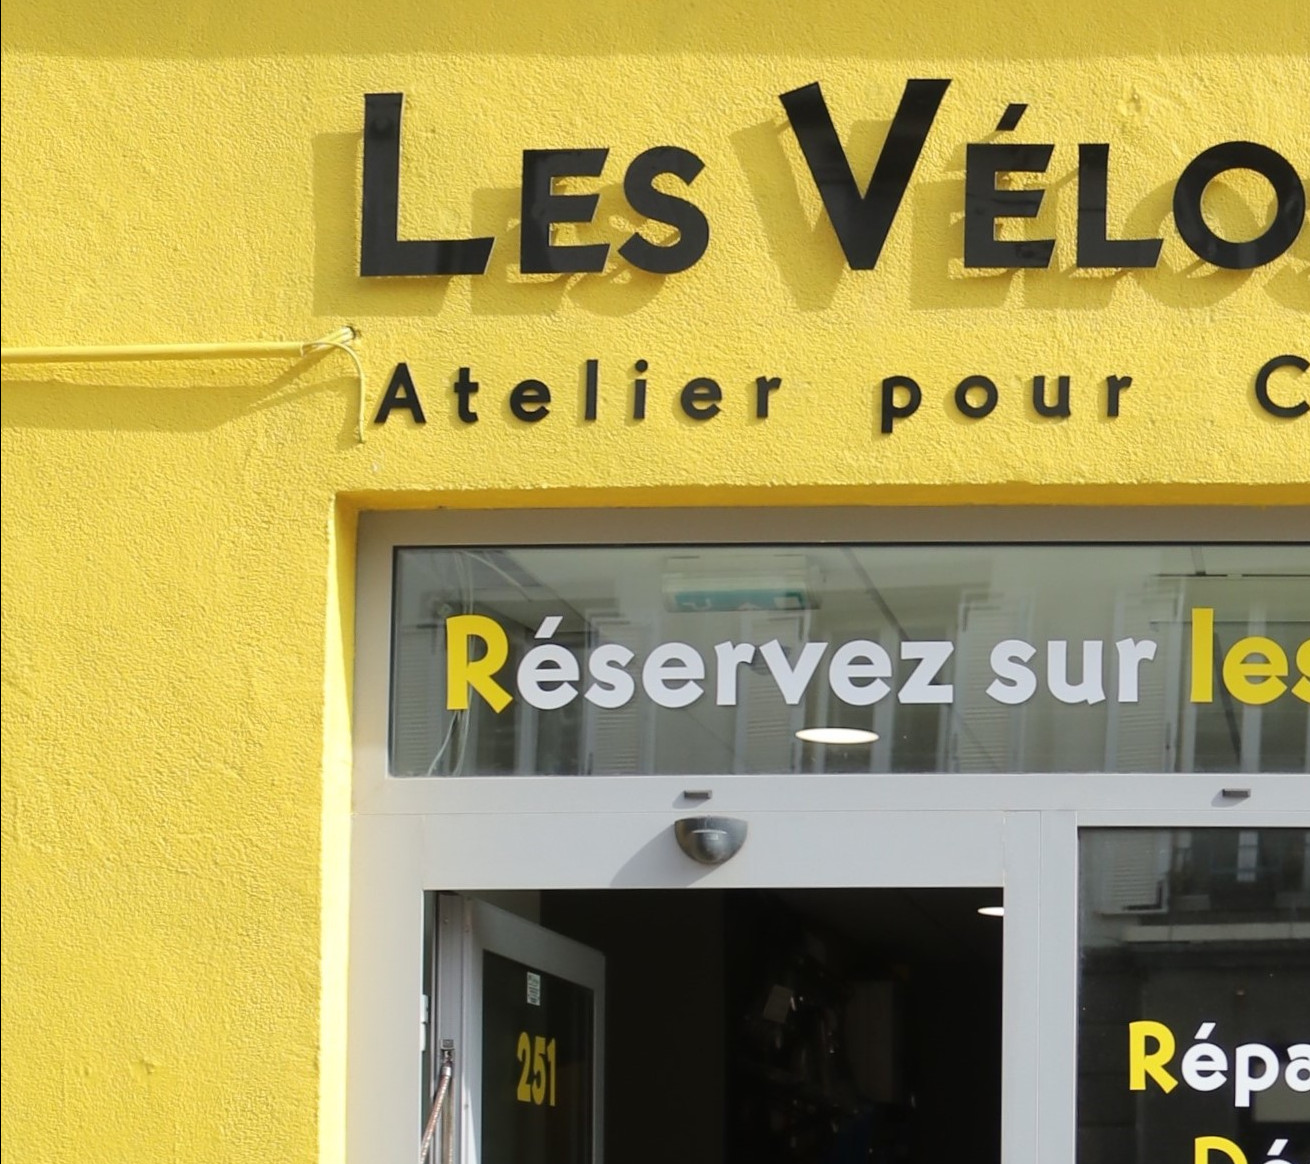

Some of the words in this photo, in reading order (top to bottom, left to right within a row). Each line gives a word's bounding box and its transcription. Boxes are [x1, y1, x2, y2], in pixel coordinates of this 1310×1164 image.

[361, 93, 709, 276] LES
[375, 360, 781, 423] Atelier
[882, 376, 1131, 433] pour
[447, 615, 953, 713] Réservez
[986, 638, 1156, 704] sur
[517, 1031, 556, 1107] 251
